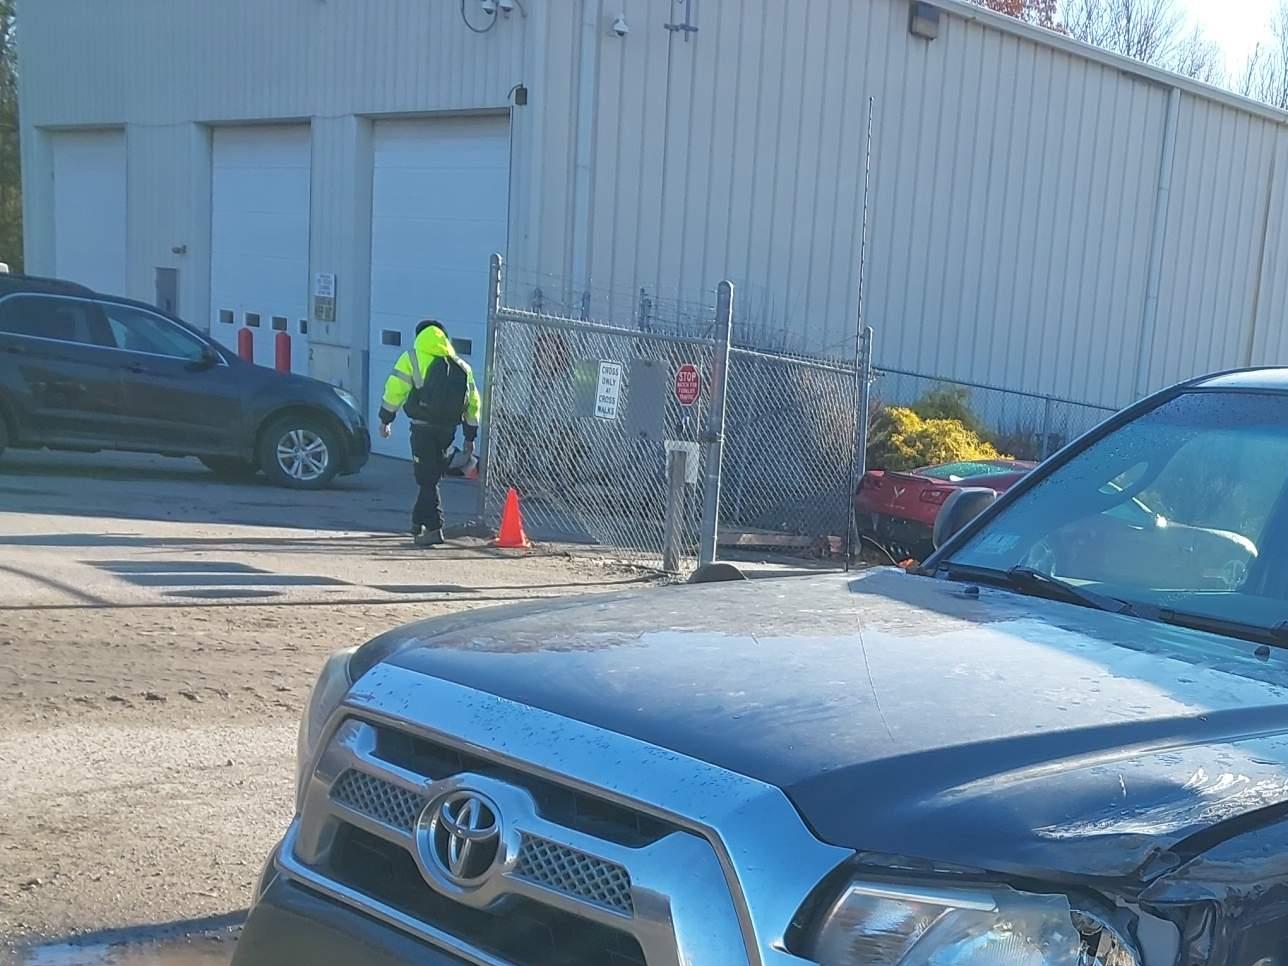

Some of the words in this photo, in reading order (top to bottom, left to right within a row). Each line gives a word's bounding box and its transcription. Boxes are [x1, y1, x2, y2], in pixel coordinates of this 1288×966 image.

[601, 366, 619, 376] CROSS
[601, 377, 616, 386] ONLY
[679, 371, 697, 382] STOP
[599, 395, 616, 404] CROSS
[597, 405, 615, 415] WALKS
